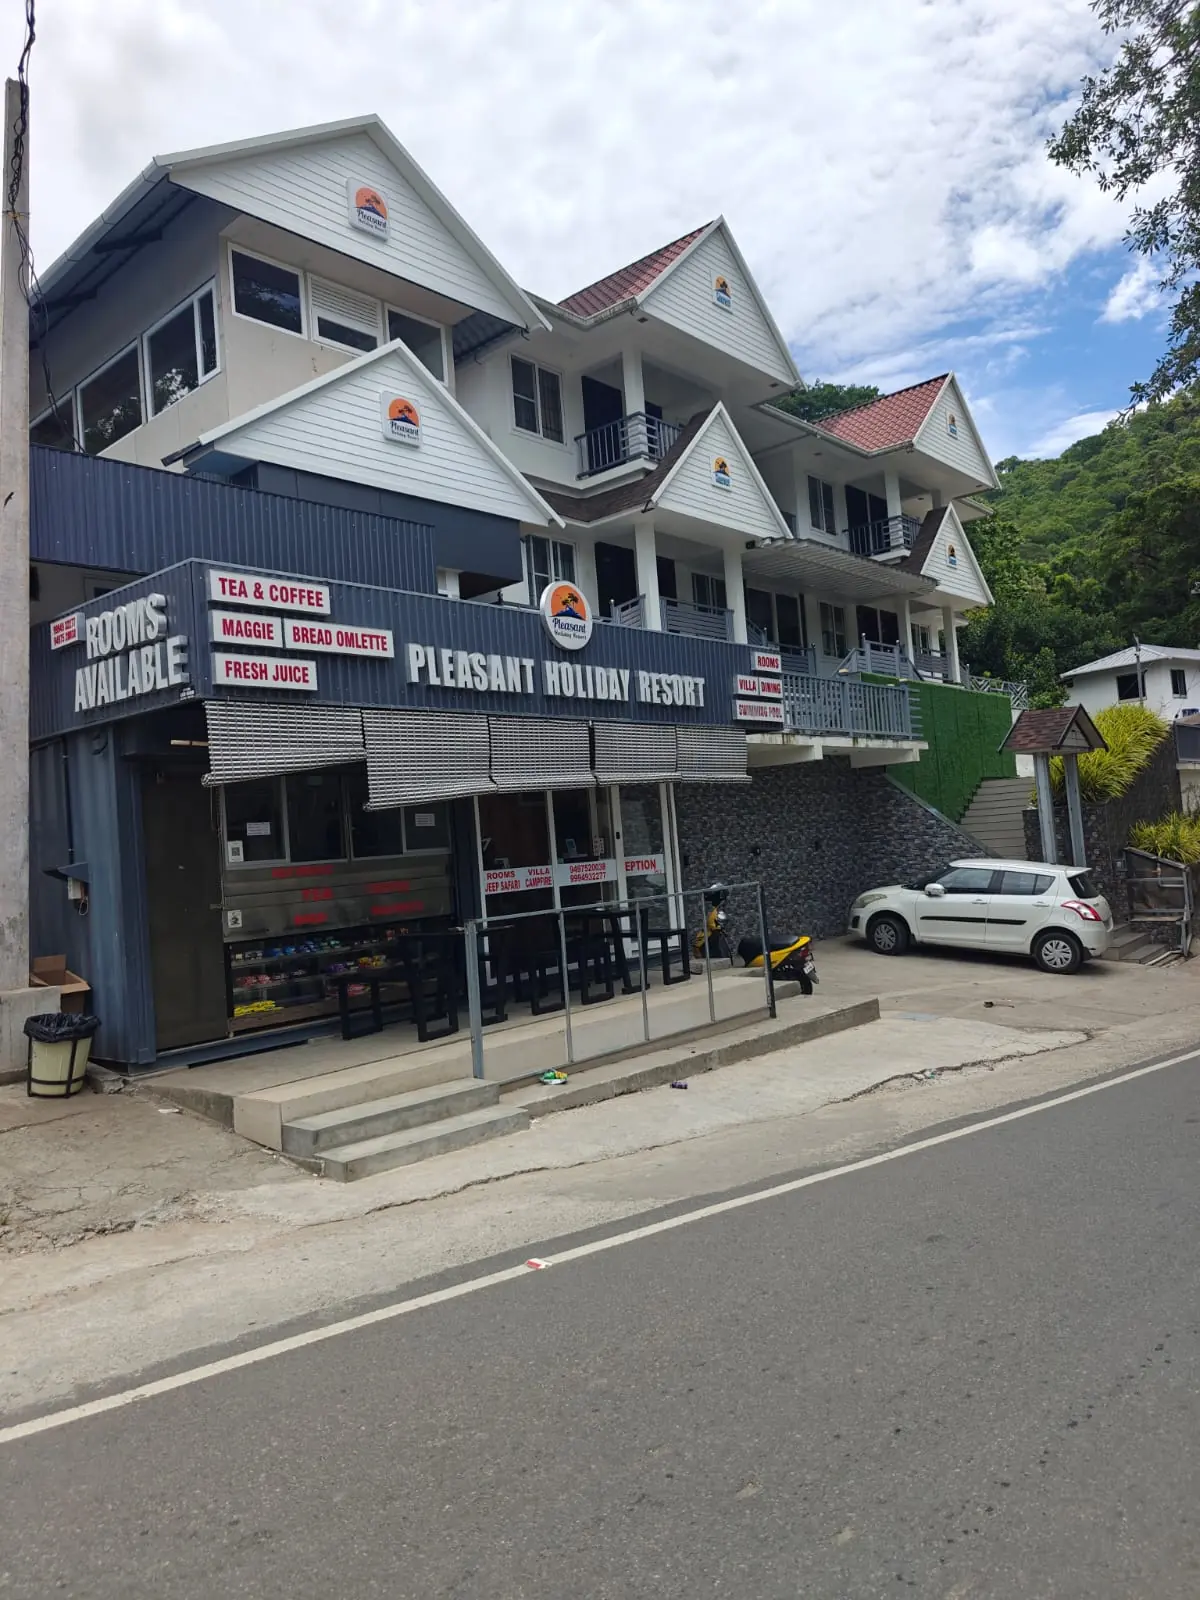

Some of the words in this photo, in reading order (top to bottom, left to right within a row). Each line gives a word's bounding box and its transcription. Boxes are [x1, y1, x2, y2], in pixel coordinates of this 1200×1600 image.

[357, 208, 387, 229] Pleasant
[390, 420, 419, 436] Pleasant
[219, 577, 248, 598] TEA
[253, 582, 264, 600] &
[269, 584, 324, 608] COFFEE
[86, 593, 167, 660] ROOMS
[222, 618, 275, 640] MAGGIE
[552, 617, 587, 633] Pleasant
[292, 626, 333, 645] BREAD
[336, 630, 389, 651] OMLETTE
[225, 660, 268, 681] FRESH
[272, 664, 309, 684] JUICE
[758, 656, 779, 669] ROOMS
[74, 634, 190, 713] AVAILABLE
[405, 642, 535, 694] PLEASANT
[541, 660, 630, 702] HOLIDAY
[634, 670, 705, 707] RESORT
[739, 680, 756, 691] VILLA
[761, 682, 781, 694] DINING
[739, 705, 767, 717] SWIMMING
[485, 881, 500, 893] JEEP
[501, 880, 520, 890] SAFARI
[525, 876, 552, 888] CAMPFIRE
[487, 871, 515, 880] ROOMS
